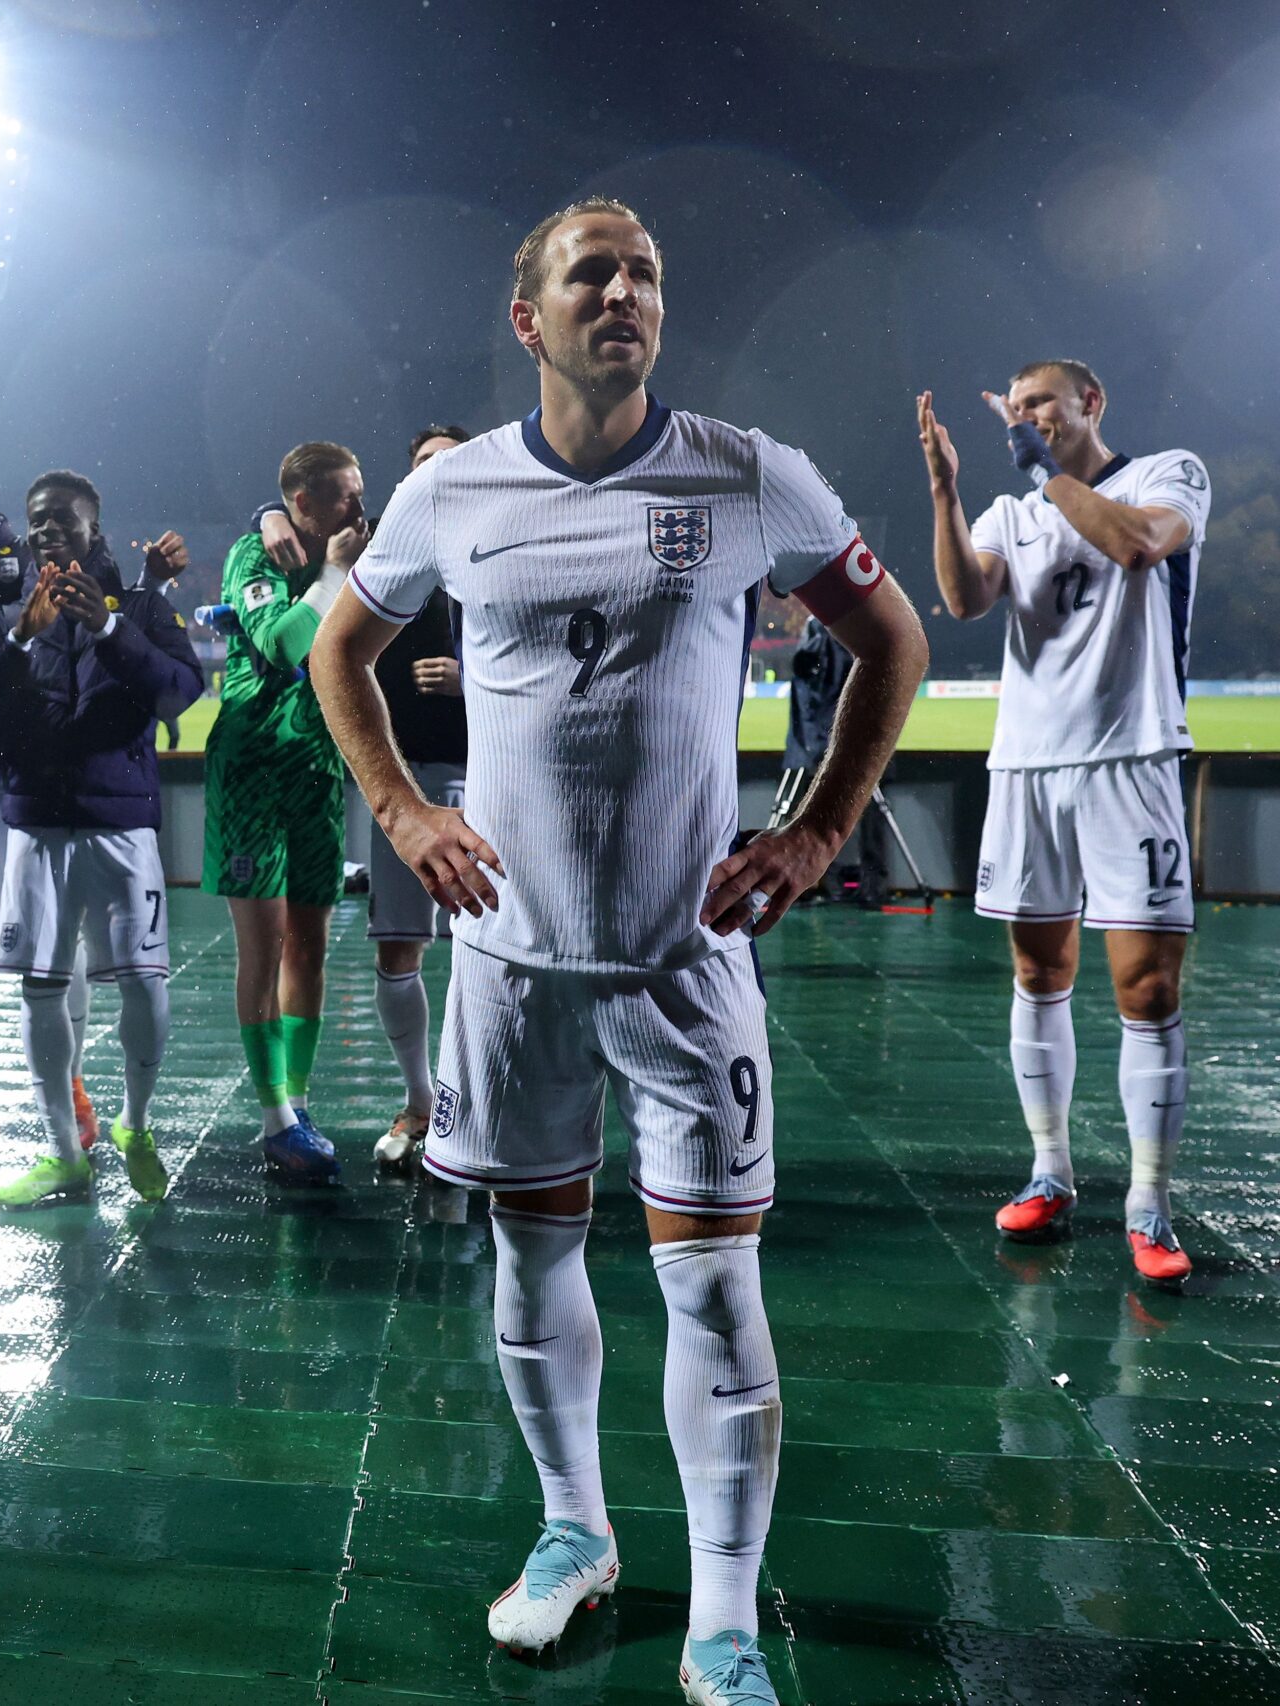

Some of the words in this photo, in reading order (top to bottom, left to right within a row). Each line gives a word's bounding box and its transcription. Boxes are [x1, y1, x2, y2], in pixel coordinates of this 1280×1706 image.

[659, 577, 694, 589] LATVIA
[845, 542, 880, 586] C
[1052, 562, 1094, 615] 12
[568, 608, 609, 698] 9
[1139, 837, 1184, 889] 12
[145, 889, 161, 935] 7
[730, 1055, 760, 1143] 9
